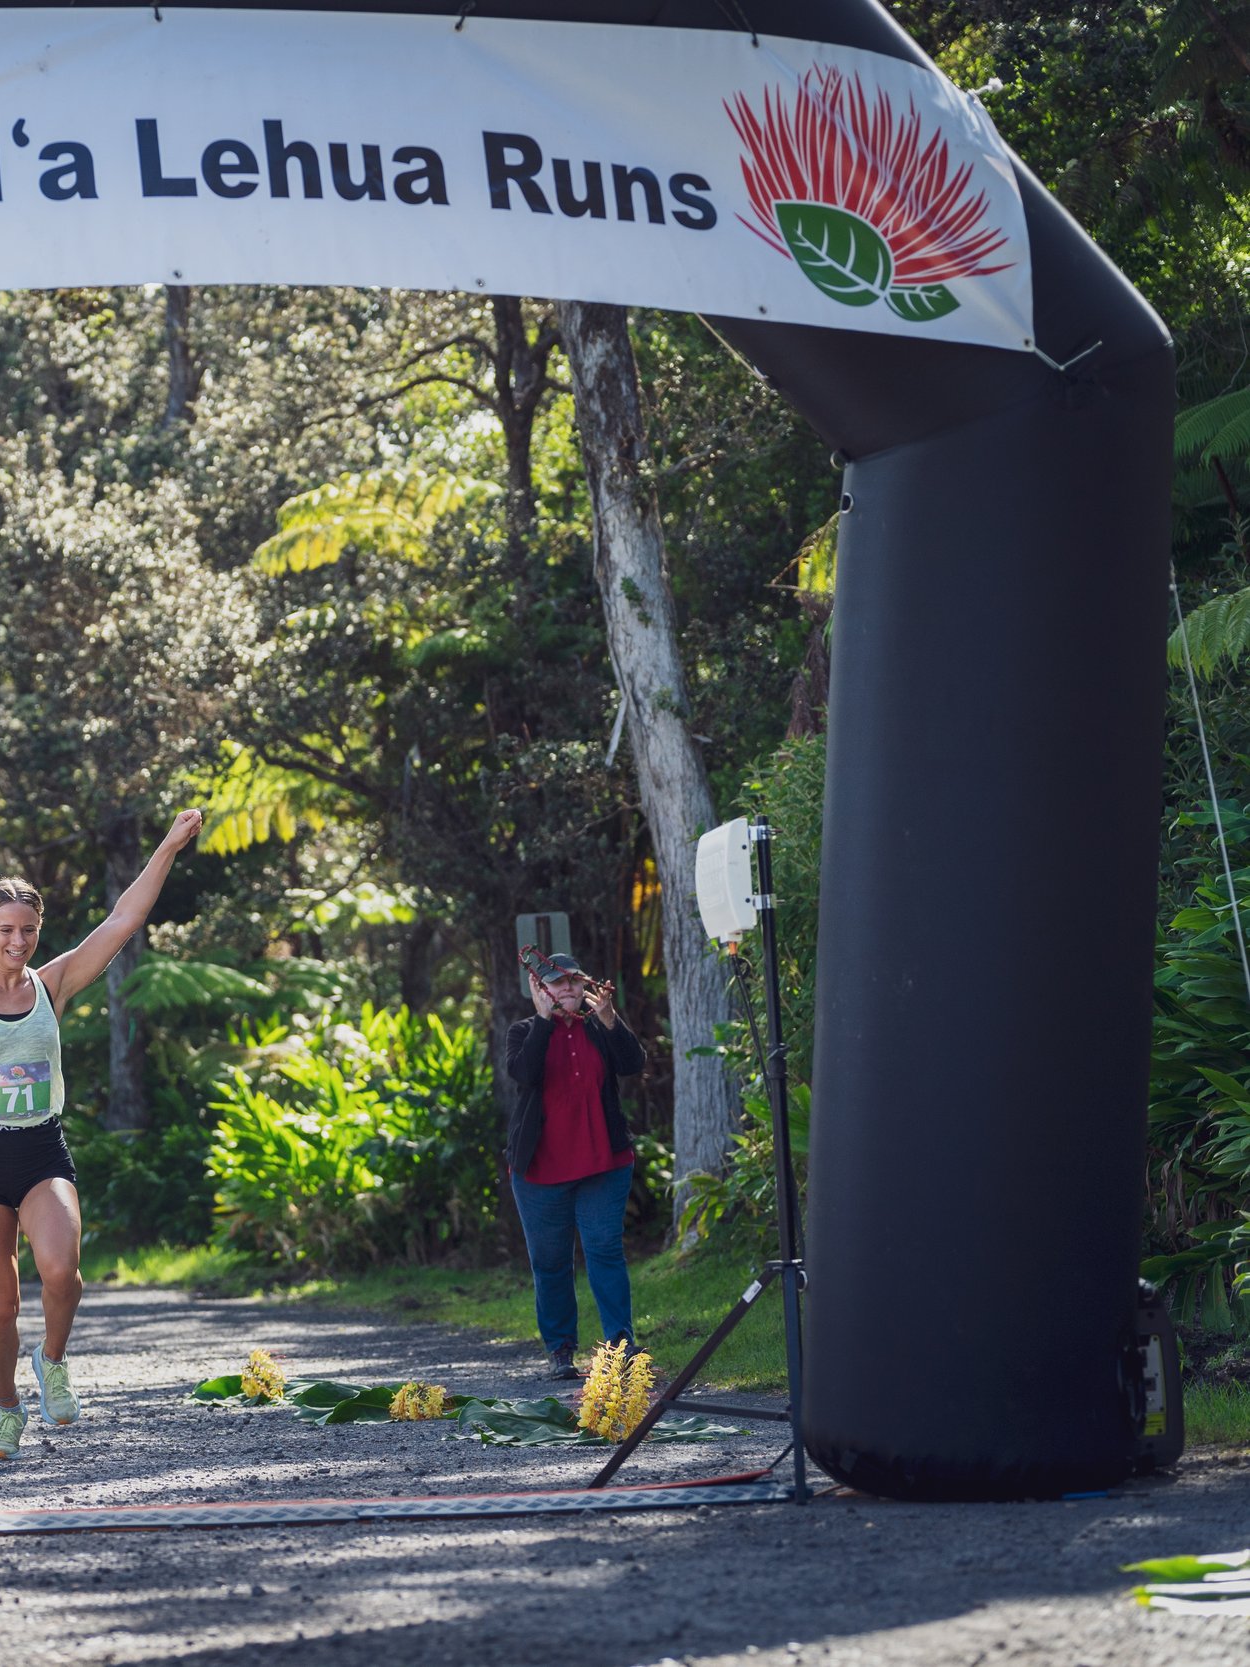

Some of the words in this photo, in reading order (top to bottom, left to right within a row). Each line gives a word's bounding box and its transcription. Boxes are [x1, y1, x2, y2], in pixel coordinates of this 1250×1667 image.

[134, 117, 451, 206] Lehua
[481, 130, 718, 231] Runs
[2, 1084, 34, 1113] 71
